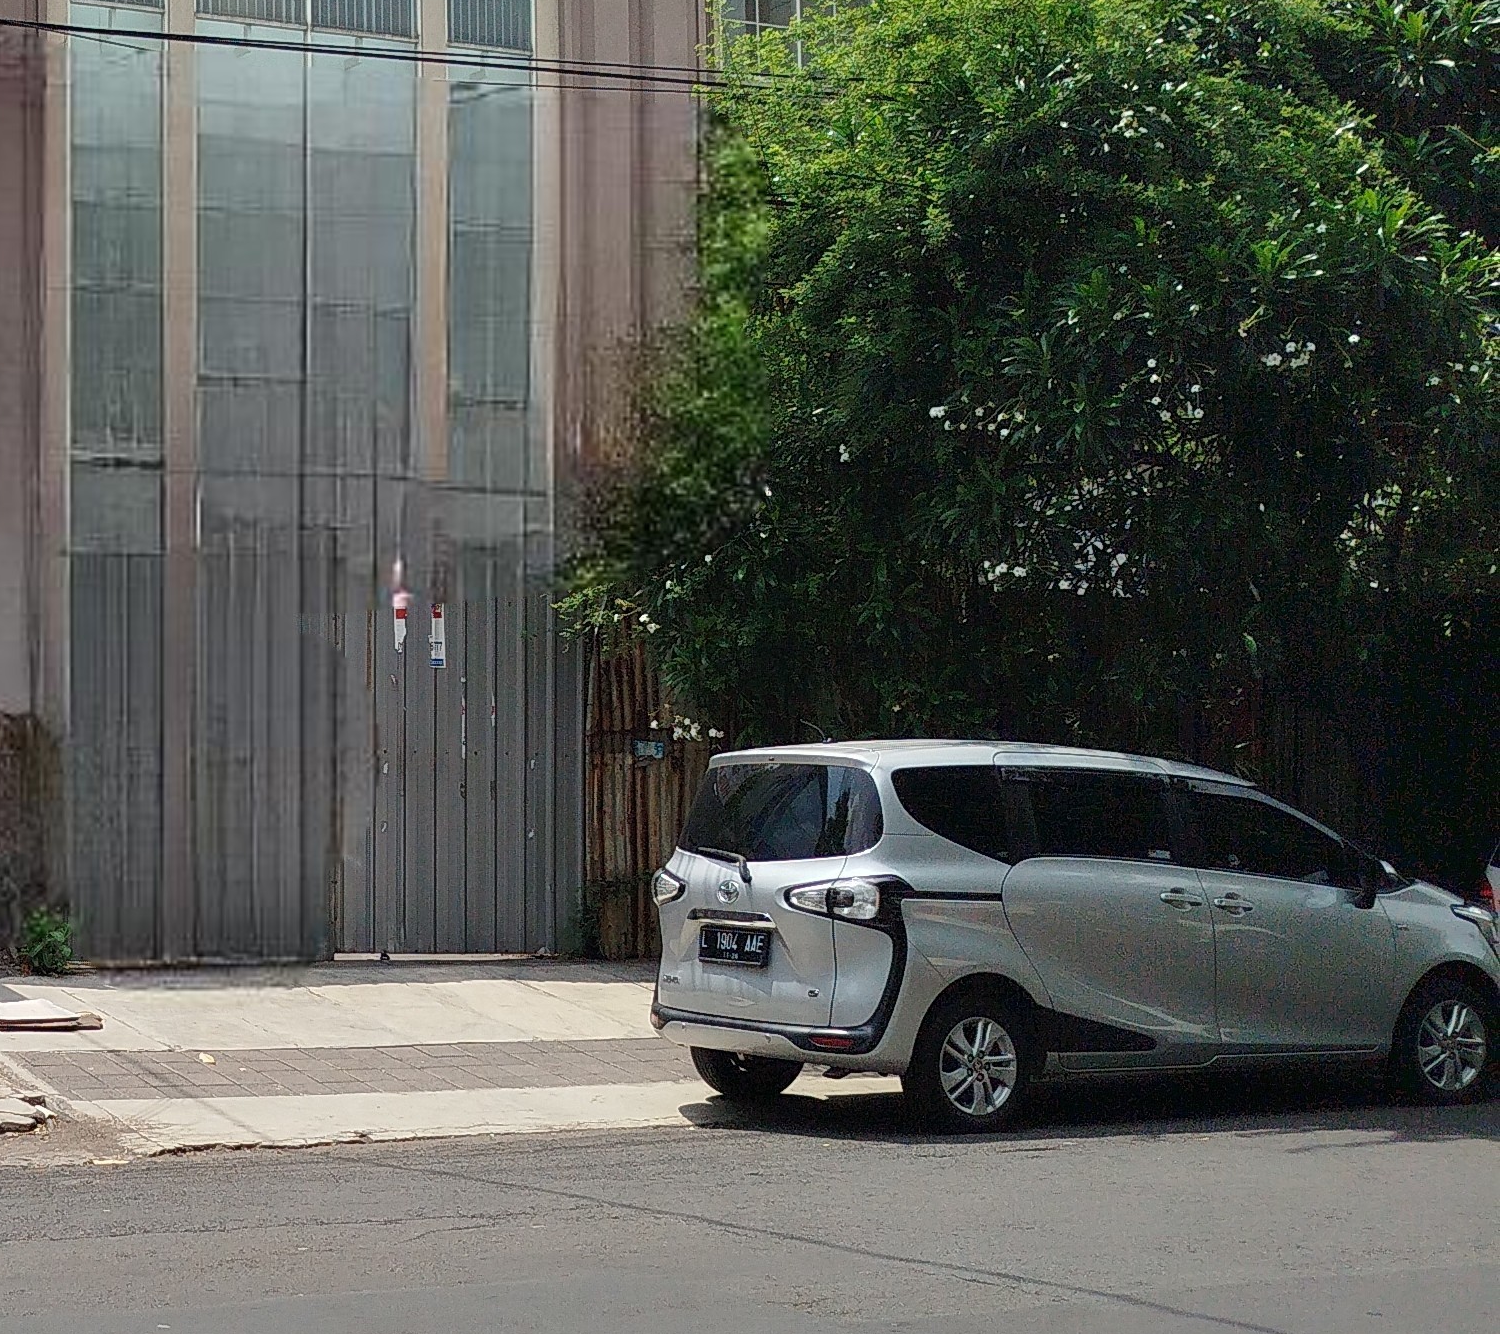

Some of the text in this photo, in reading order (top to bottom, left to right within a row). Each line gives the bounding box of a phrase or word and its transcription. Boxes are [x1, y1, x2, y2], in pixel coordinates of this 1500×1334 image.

[702, 931, 765, 953] L 1904 AAE
